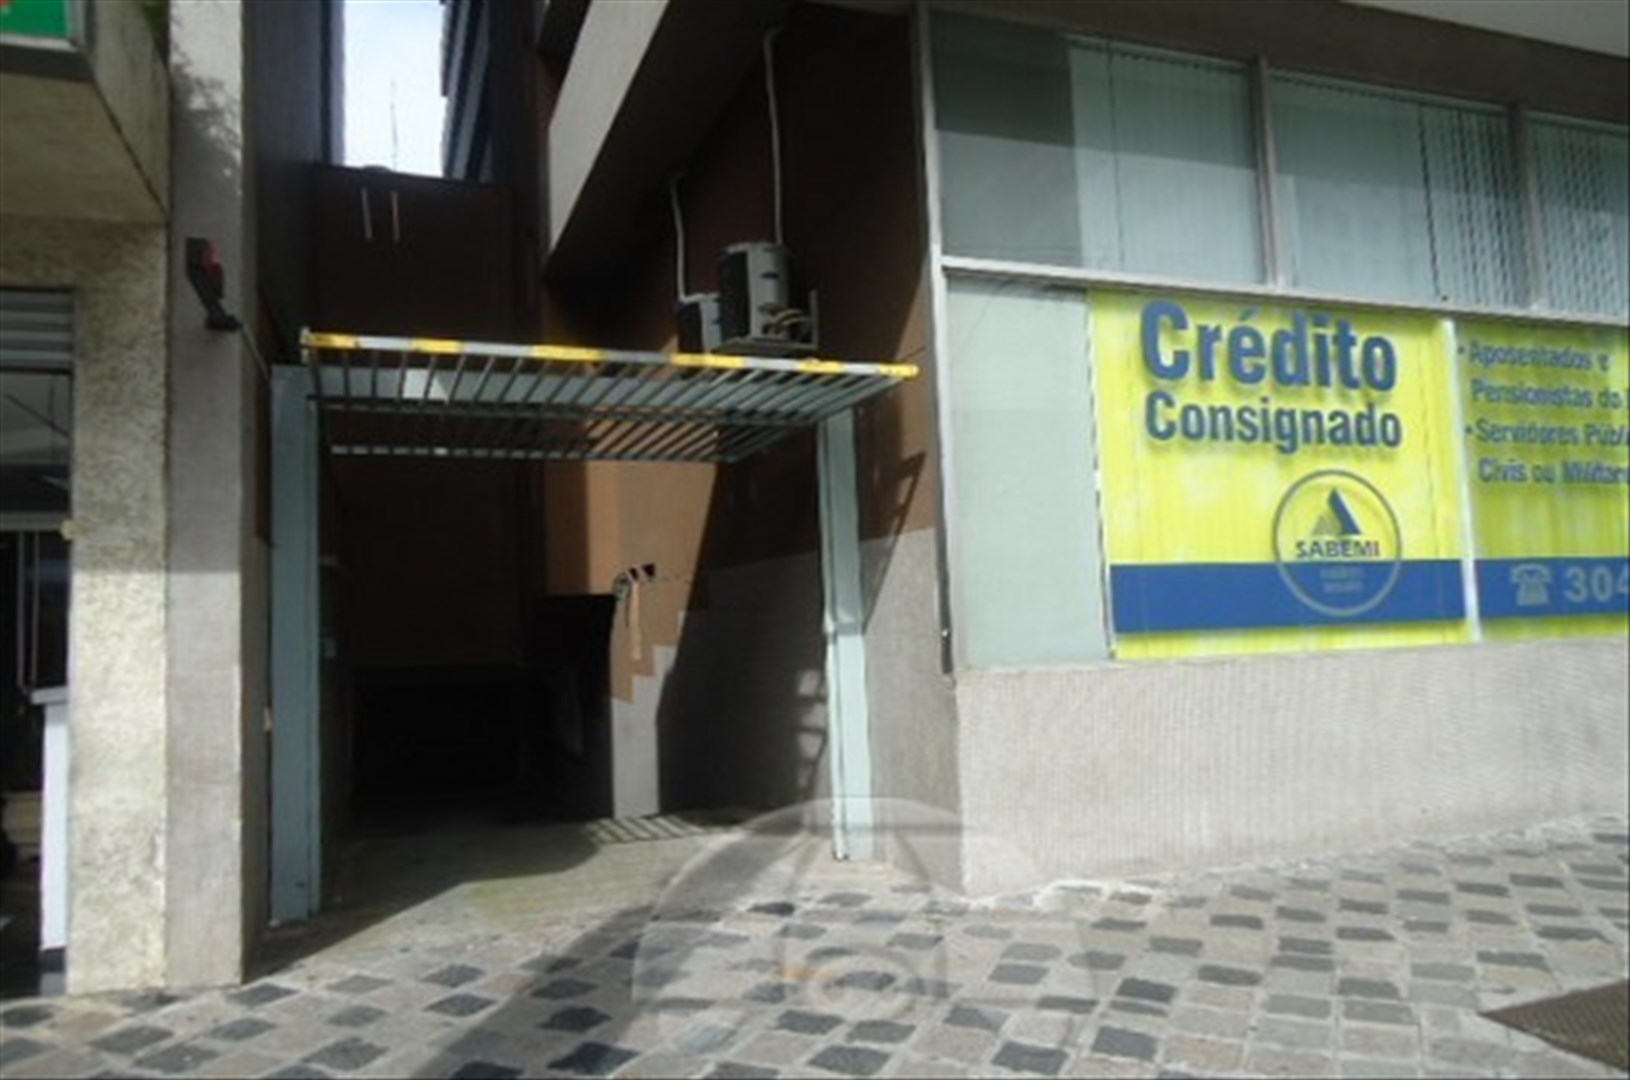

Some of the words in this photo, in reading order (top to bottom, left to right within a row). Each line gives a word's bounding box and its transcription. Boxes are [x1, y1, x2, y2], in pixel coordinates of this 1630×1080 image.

[1141, 299, 1396, 391] Crédito
[1145, 390, 1403, 454] Consignado
[1295, 540, 1380, 558] SABEMI
